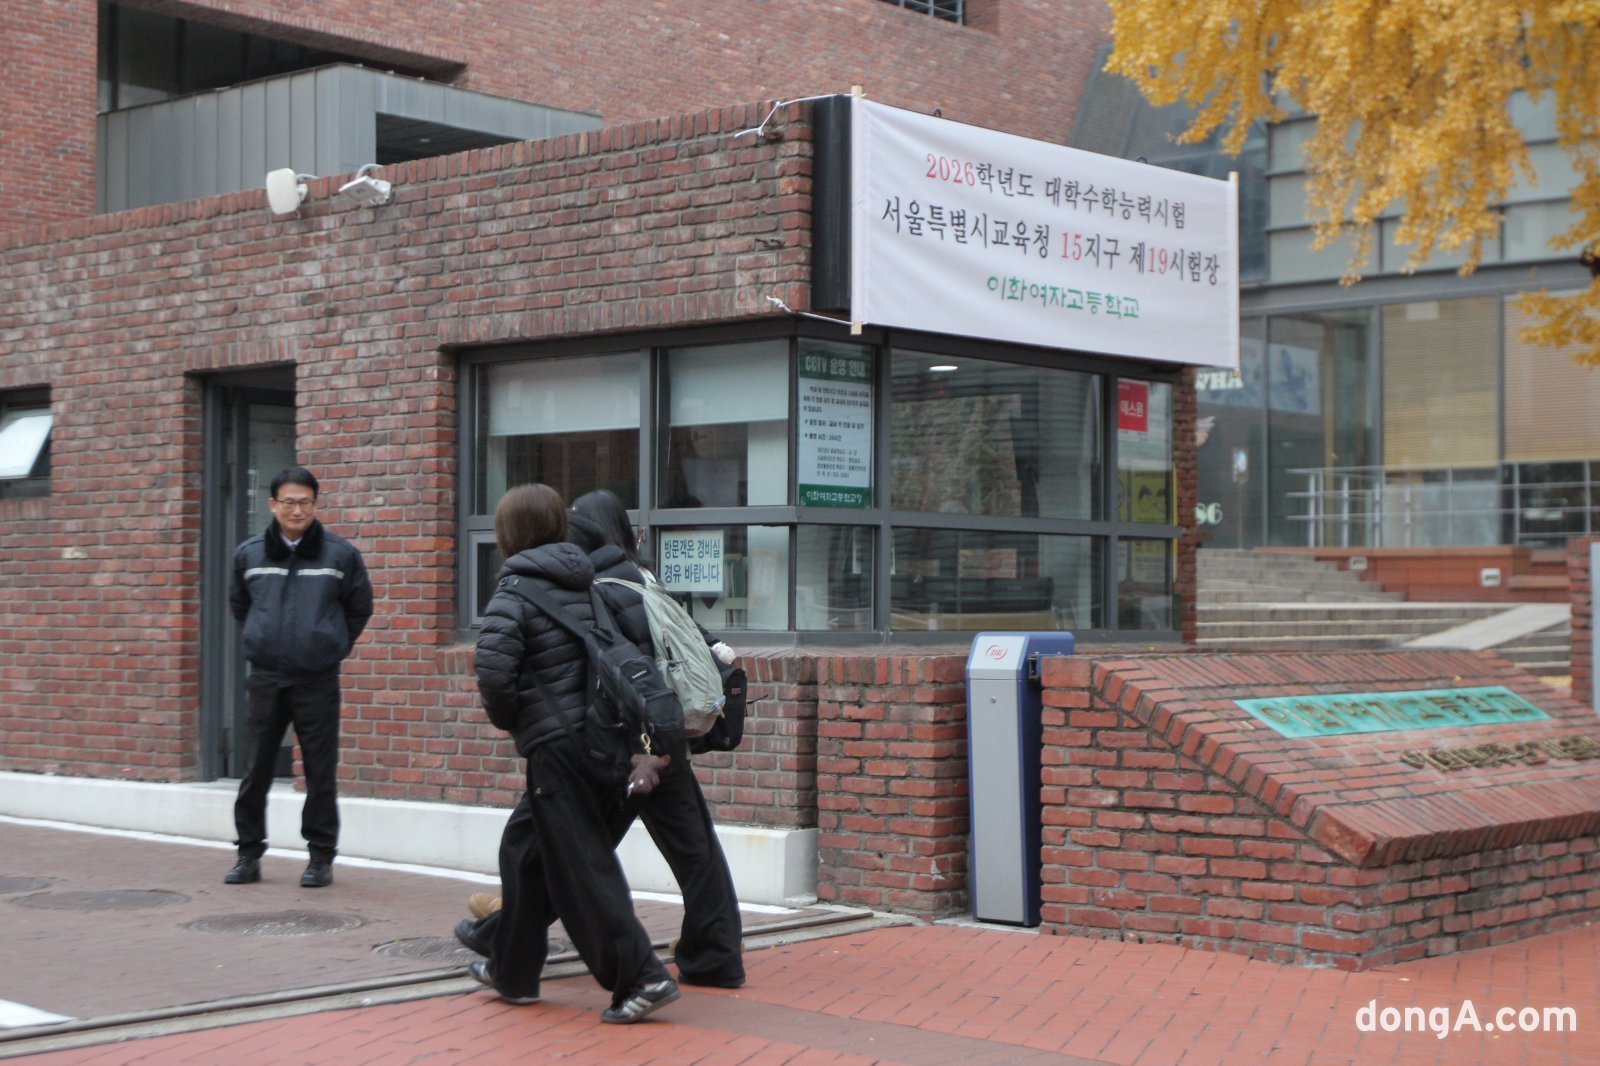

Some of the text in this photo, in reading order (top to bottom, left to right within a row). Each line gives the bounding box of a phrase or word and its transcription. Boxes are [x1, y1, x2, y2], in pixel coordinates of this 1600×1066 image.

[926, 153, 1185, 229] 2026학년도 대학수학능력시험
[882, 196, 1220, 286] 서울특별시교육청 15지구 제19시험장
[987, 276, 1139, 319] 이화여자고등학교
[805, 355, 827, 373] CCTV
[1120, 400, 1144, 418] 에스원
[665, 538, 721, 560] 방문객은 경비실
[664, 562, 720, 584] 경유 바랍니다
[1258, 692, 1531, 730] 이화여자고등학교
